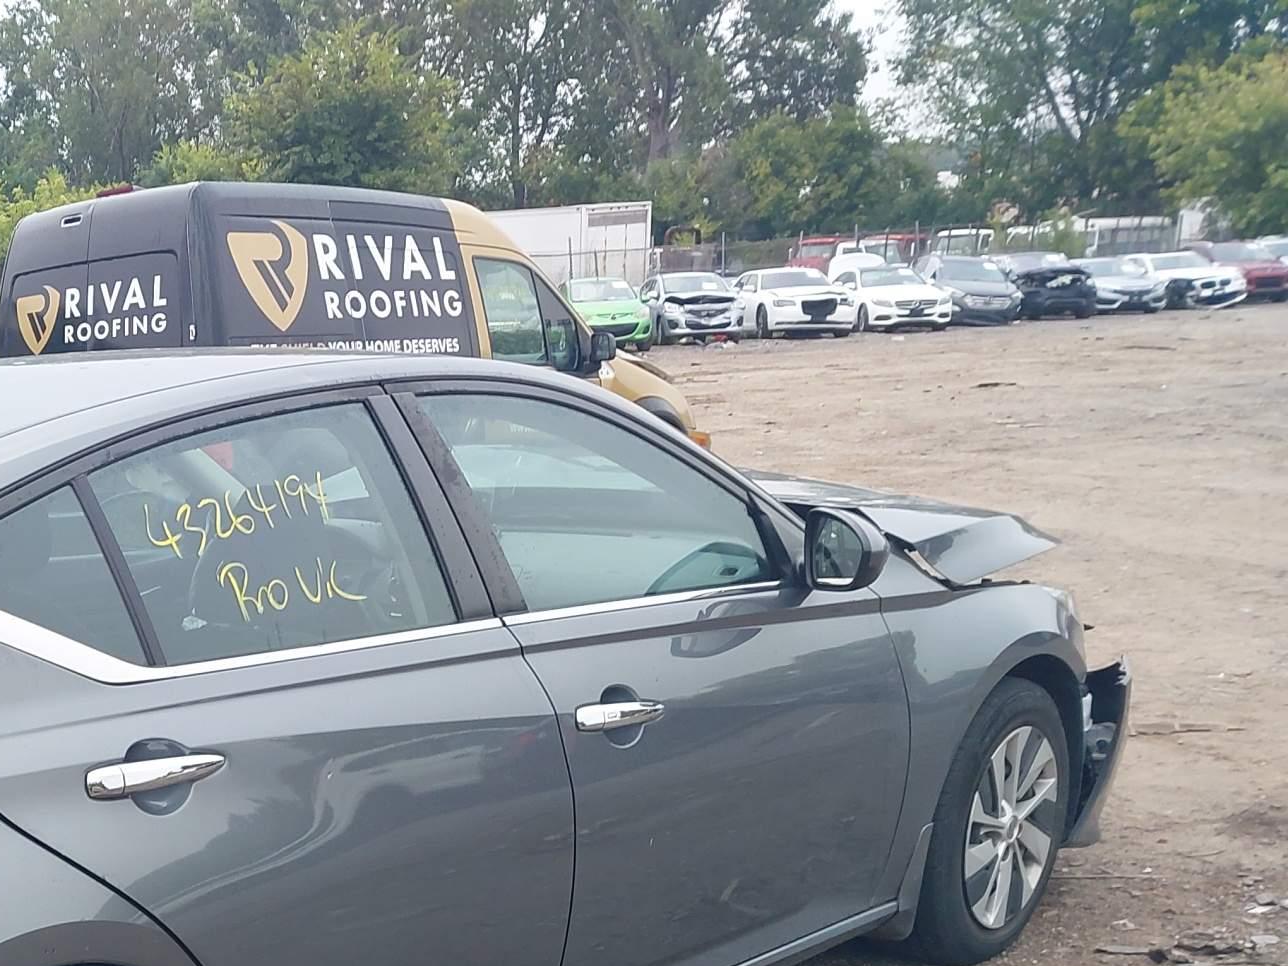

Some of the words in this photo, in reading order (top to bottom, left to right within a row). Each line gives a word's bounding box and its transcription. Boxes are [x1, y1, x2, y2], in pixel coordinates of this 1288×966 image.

[312, 234, 457, 280] RIVAL
[64, 274, 168, 319] RIVAL
[324, 290, 463, 319] ROOFING
[64, 312, 168, 344] ROOFING
[364, 339, 402, 353] HOME
[402, 337, 461, 354] DESERVES
[143, 471, 330, 560] 43264194
